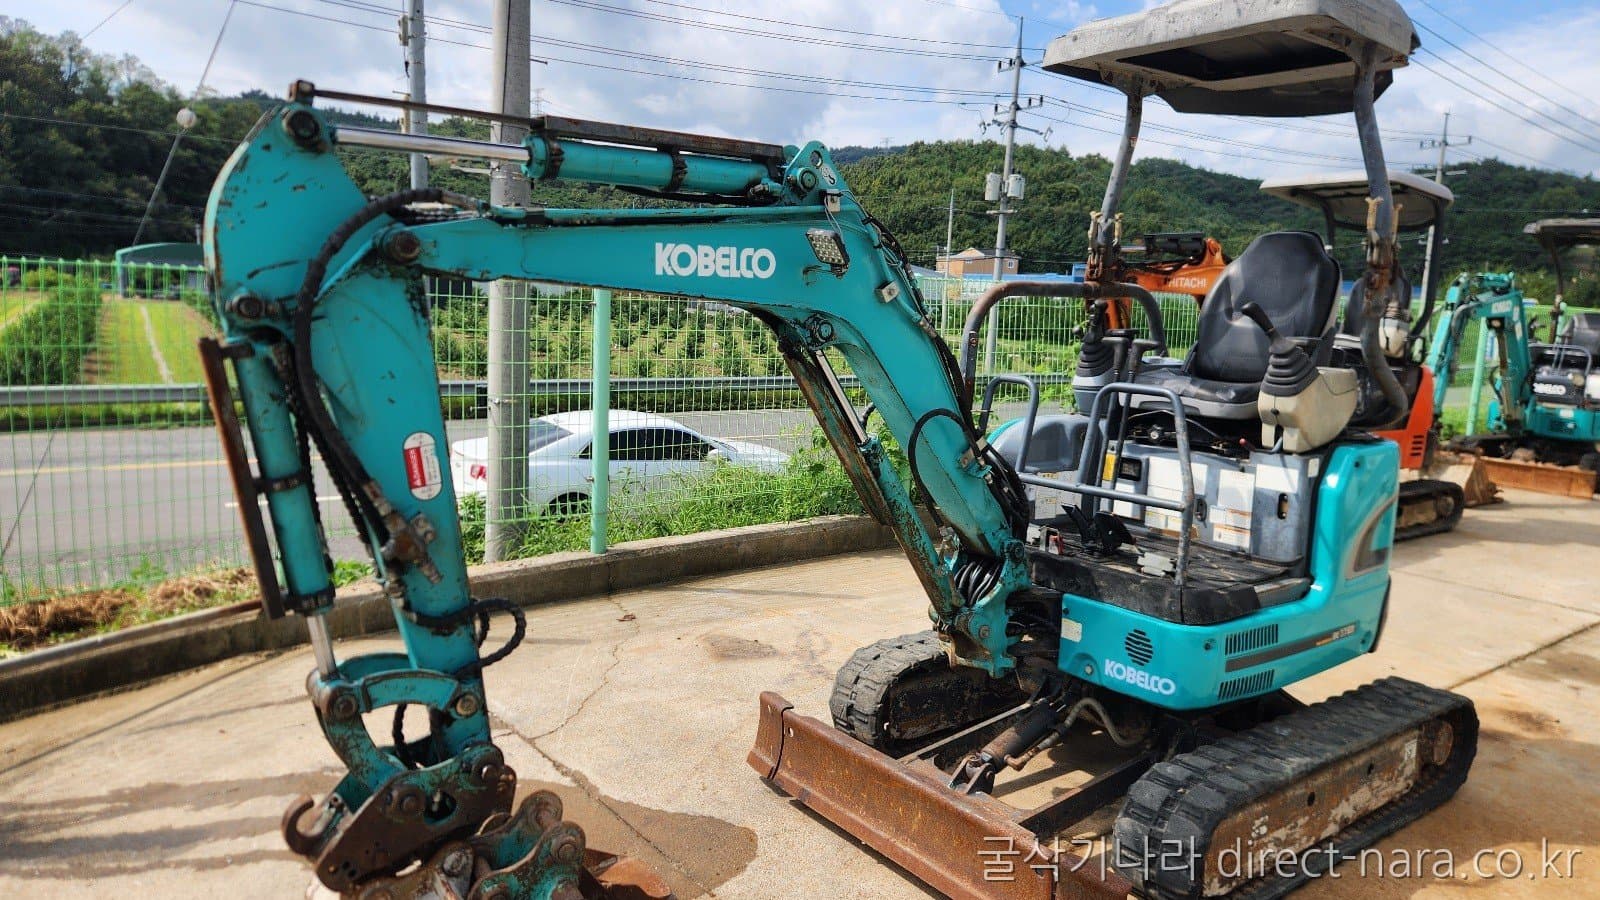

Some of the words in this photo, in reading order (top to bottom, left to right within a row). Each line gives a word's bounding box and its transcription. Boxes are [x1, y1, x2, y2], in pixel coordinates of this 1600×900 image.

[655, 242, 776, 279] KOBELCO
[1168, 276, 1207, 289] HITACHI
[1104, 658, 1176, 695] KOBELCO
